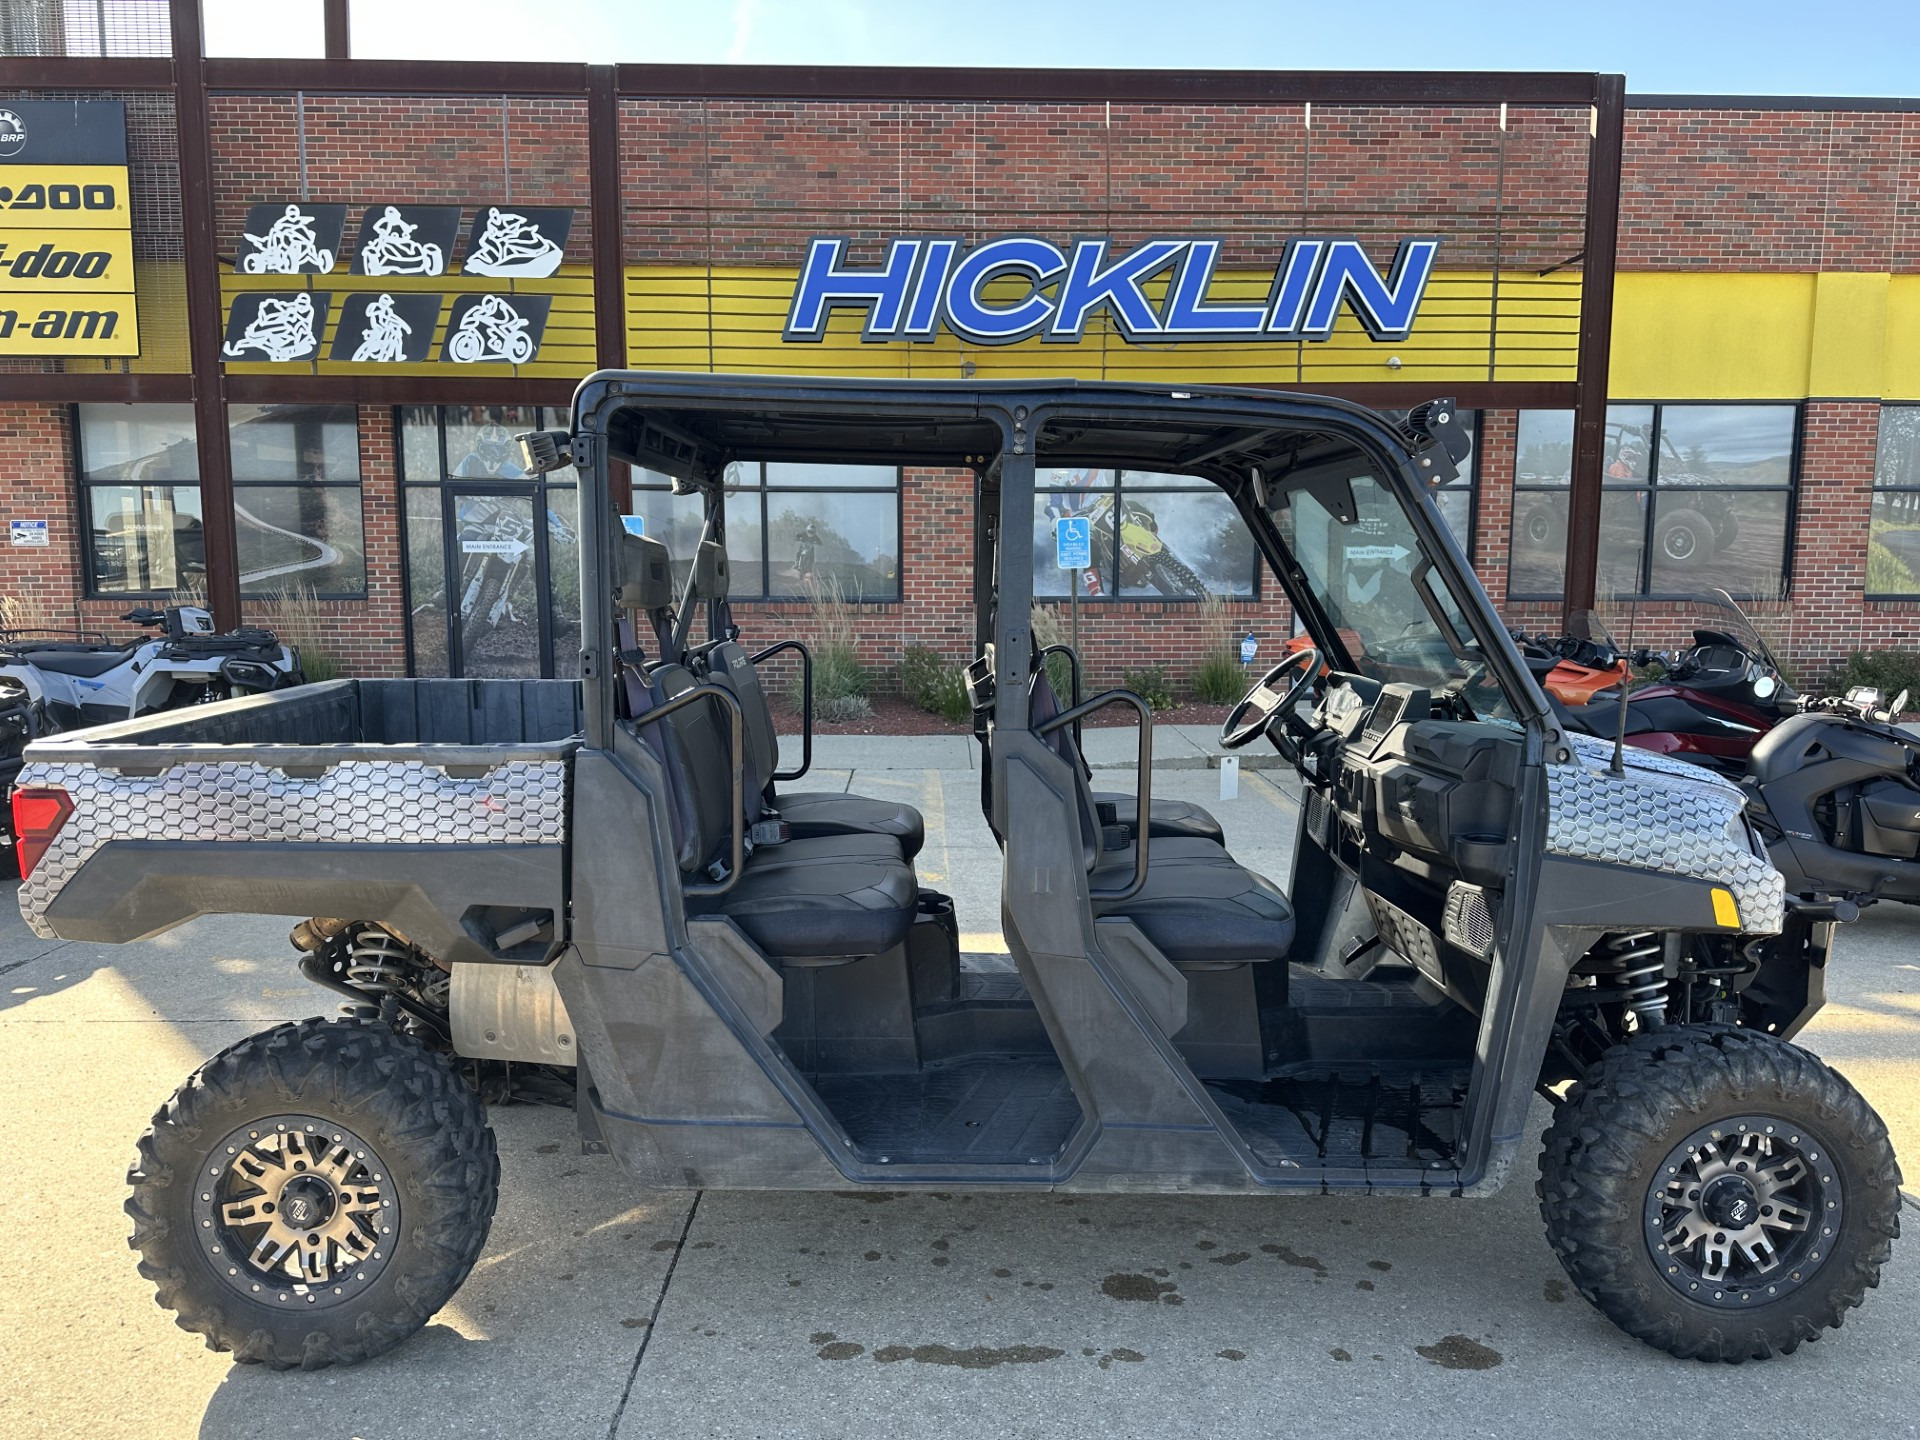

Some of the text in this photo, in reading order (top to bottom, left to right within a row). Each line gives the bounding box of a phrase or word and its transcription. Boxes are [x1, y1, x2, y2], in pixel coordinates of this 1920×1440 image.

[1, 133, 25, 142] BRP
[0, 243, 112, 278] -doo
[788, 237, 1440, 339] HICKLIN
[292, 1200, 308, 1219] TUSK
[1730, 1202, 1748, 1218] TUSK
